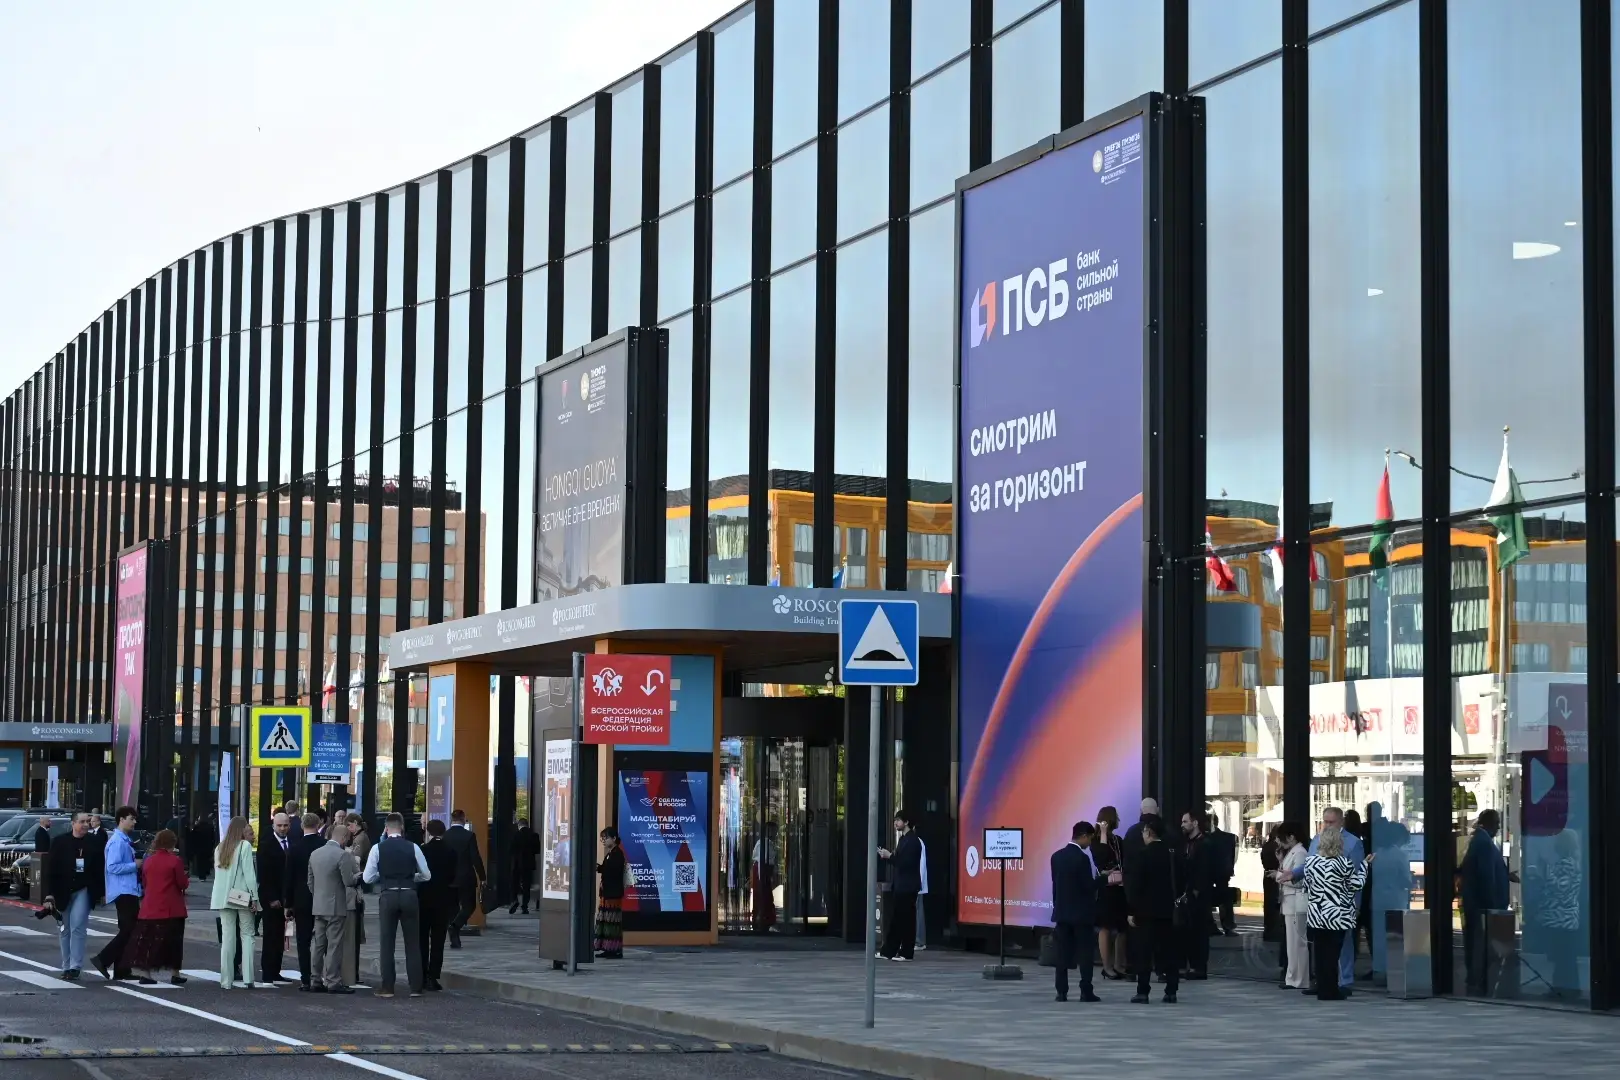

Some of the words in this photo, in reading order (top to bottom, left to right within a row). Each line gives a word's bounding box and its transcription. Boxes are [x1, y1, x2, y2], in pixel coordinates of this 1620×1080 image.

[1076, 248, 1101, 270] банк
[1076, 259, 1119, 290] сильной
[1002, 258, 1070, 337] ПСБ
[1076, 286, 1113, 312] страны
[970, 408, 1057, 458] смотрим
[546, 468, 581, 503] HONGQI
[584, 456, 616, 491] GUOYA
[970, 484, 990, 514] за
[995, 460, 1087, 513] горизонт
[542, 508, 572, 532] ВЕЛИЧИЕ
[573, 504, 586, 524] ВНЕ
[588, 494, 620, 520] ВРЕМЕНИ
[558, 603, 597, 622] РОСКОНГРЕСС
[794, 598, 840, 612] ROSC
[794, 616, 824, 626] Building
[826, 617, 840, 626] Tru
[119, 620, 142, 650] ПРОСТО
[124, 650, 136, 676] ТАК
[591, 706, 663, 716] ВСЕРОССИЙСКАЯ
[602, 716, 652, 724] ФЕДЕРАЦИЯ
[40, 727, 94, 735] ROSCONGRESS
[590, 723, 628, 732] РУССКОЙ
[631, 723, 663, 732] ТРОЙКИ
